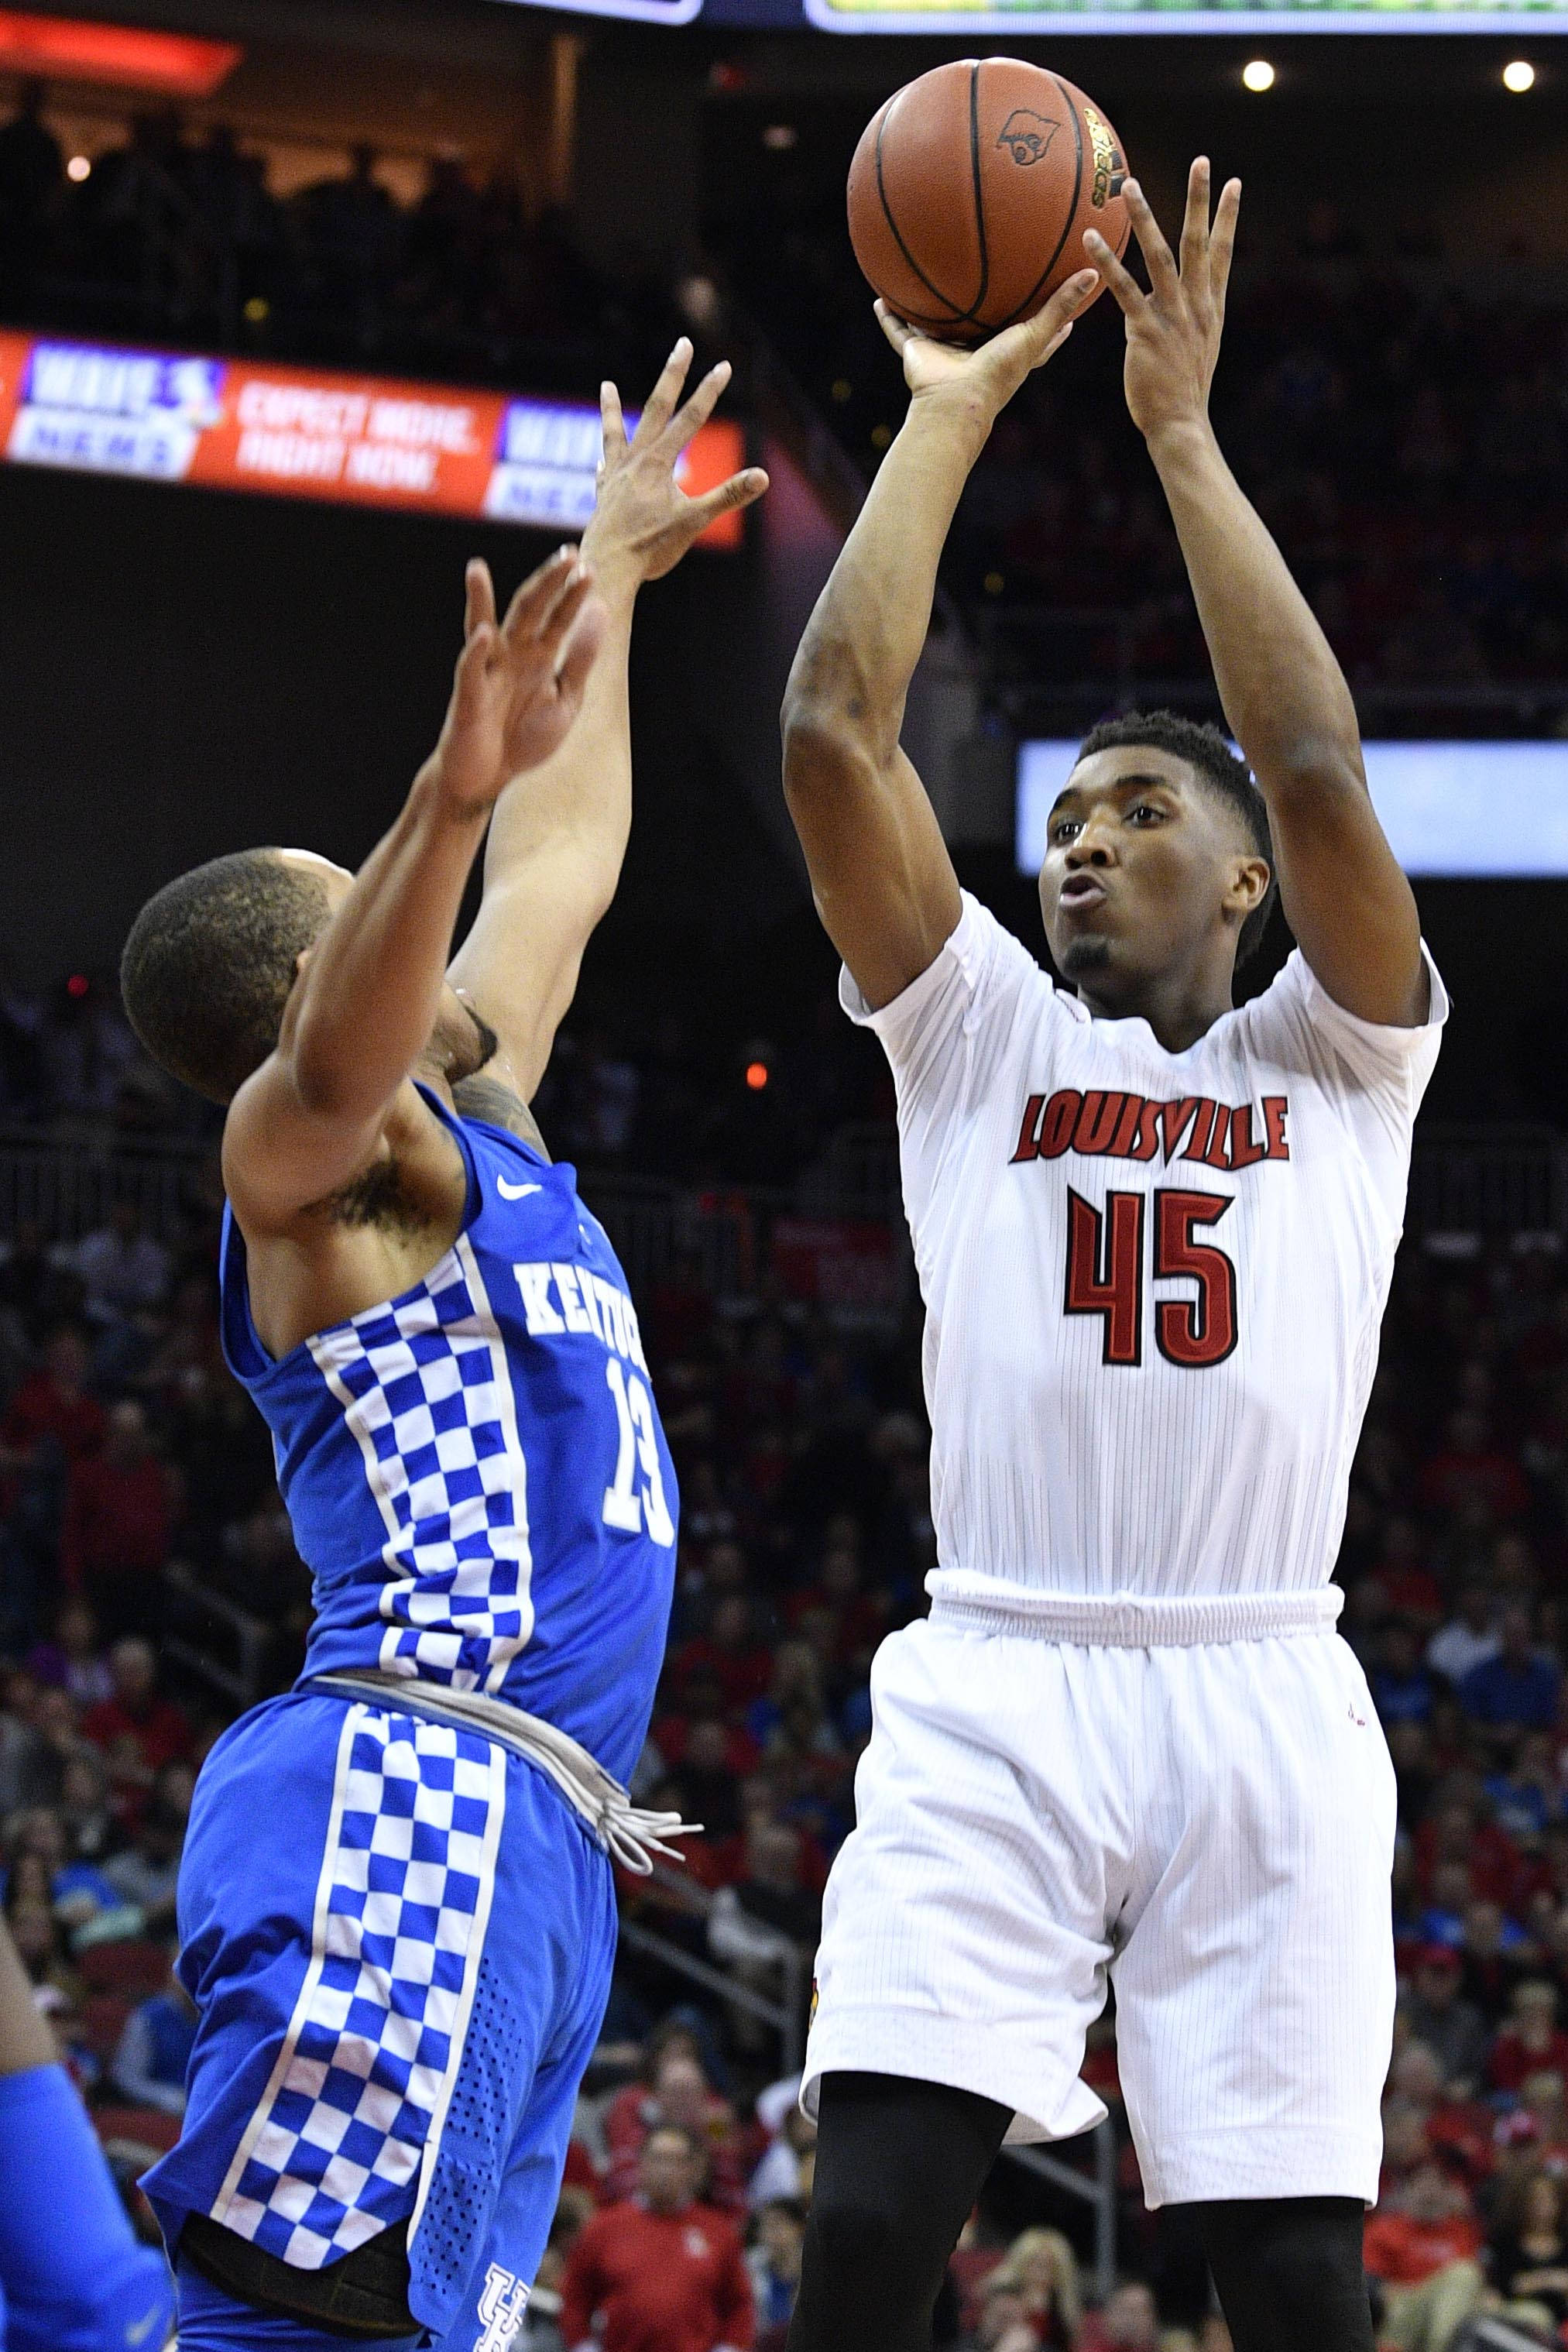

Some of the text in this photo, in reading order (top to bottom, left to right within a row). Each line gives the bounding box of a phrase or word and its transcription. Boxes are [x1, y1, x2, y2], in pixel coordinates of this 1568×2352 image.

[1007, 1089, 1290, 1171] LOUISVILLE
[513, 1262, 652, 1383] KENTUC
[1063, 1184, 1238, 1368] 45
[602, 1357, 674, 1548] 13
